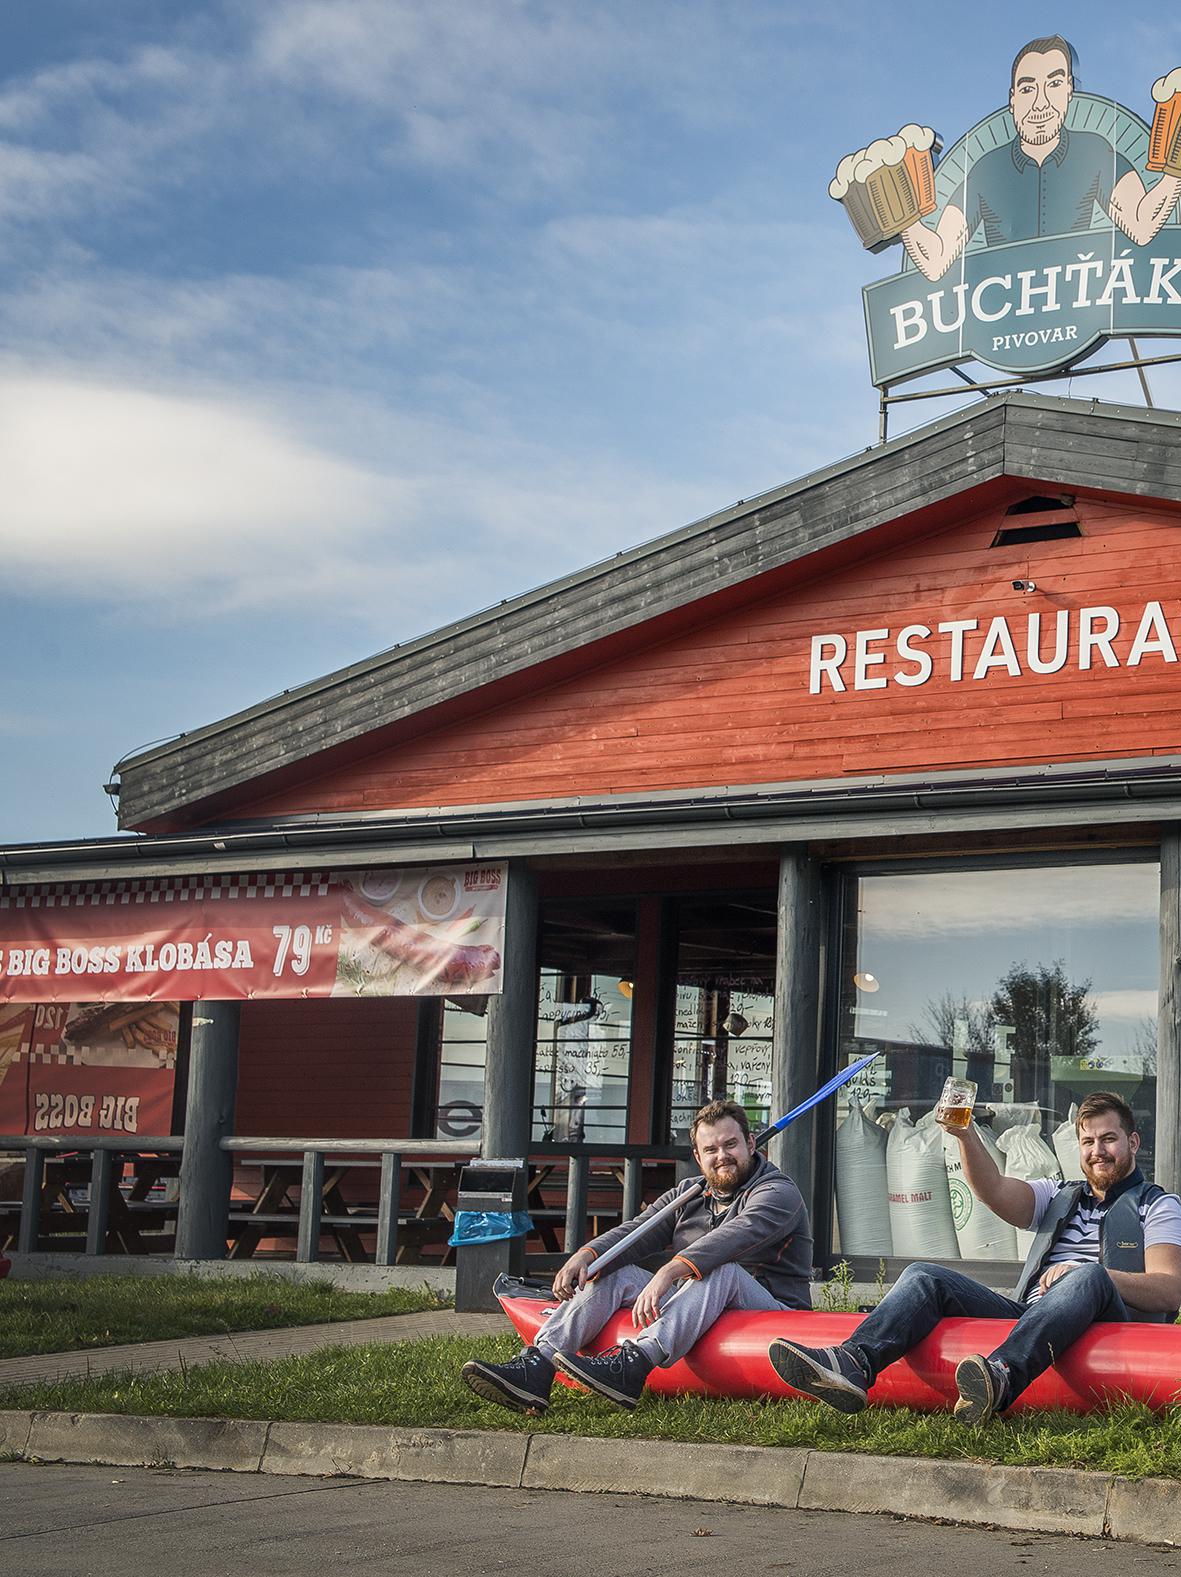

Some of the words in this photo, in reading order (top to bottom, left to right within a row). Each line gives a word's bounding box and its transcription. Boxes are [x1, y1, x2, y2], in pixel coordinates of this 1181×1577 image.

[992, 325, 1078, 351] PIVOVAR
[6, 948, 51, 976] BIG
[55, 945, 121, 974] BOSS
[125, 932, 254, 972] KLOBÁSA
[273, 925, 313, 976] 79
